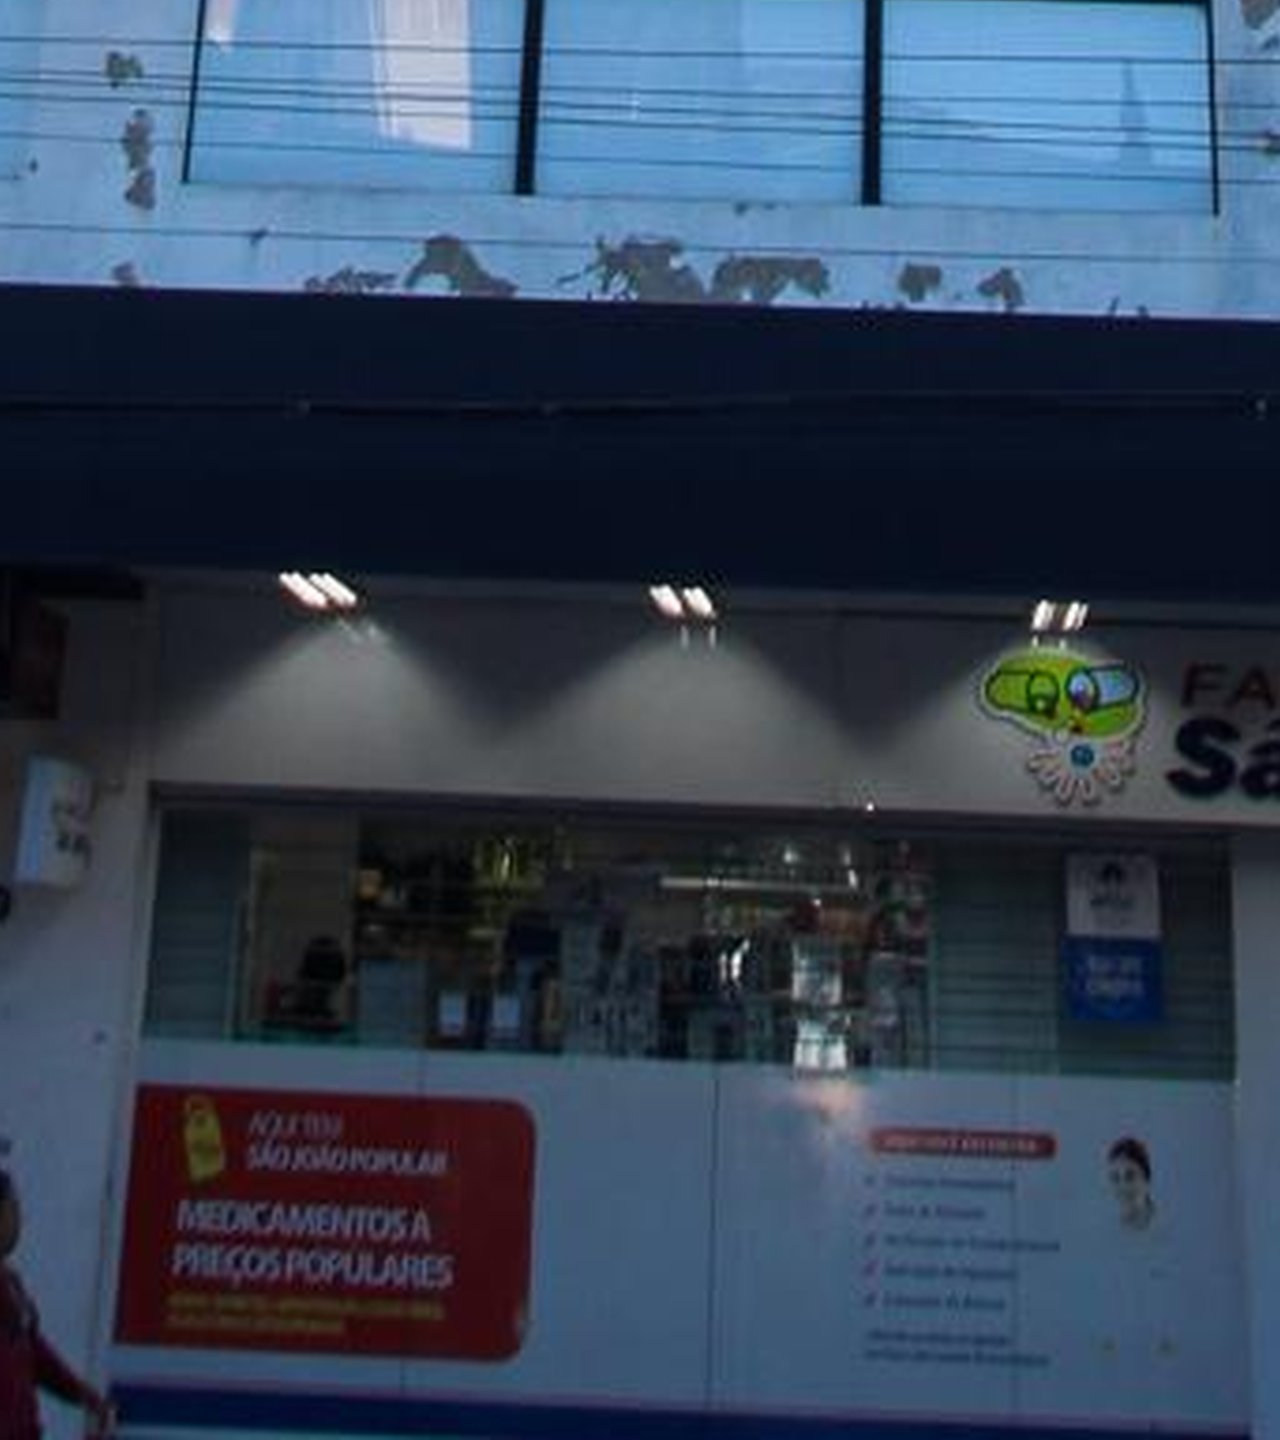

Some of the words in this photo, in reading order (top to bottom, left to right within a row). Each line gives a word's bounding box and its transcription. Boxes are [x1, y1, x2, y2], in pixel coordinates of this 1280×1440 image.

[176, 1198, 406, 1243] MEDICAMENTOS
[410, 1208, 432, 1243] A
[171, 1242, 283, 1292] PREÇOS
[284, 1247, 455, 1291] POPULARES
